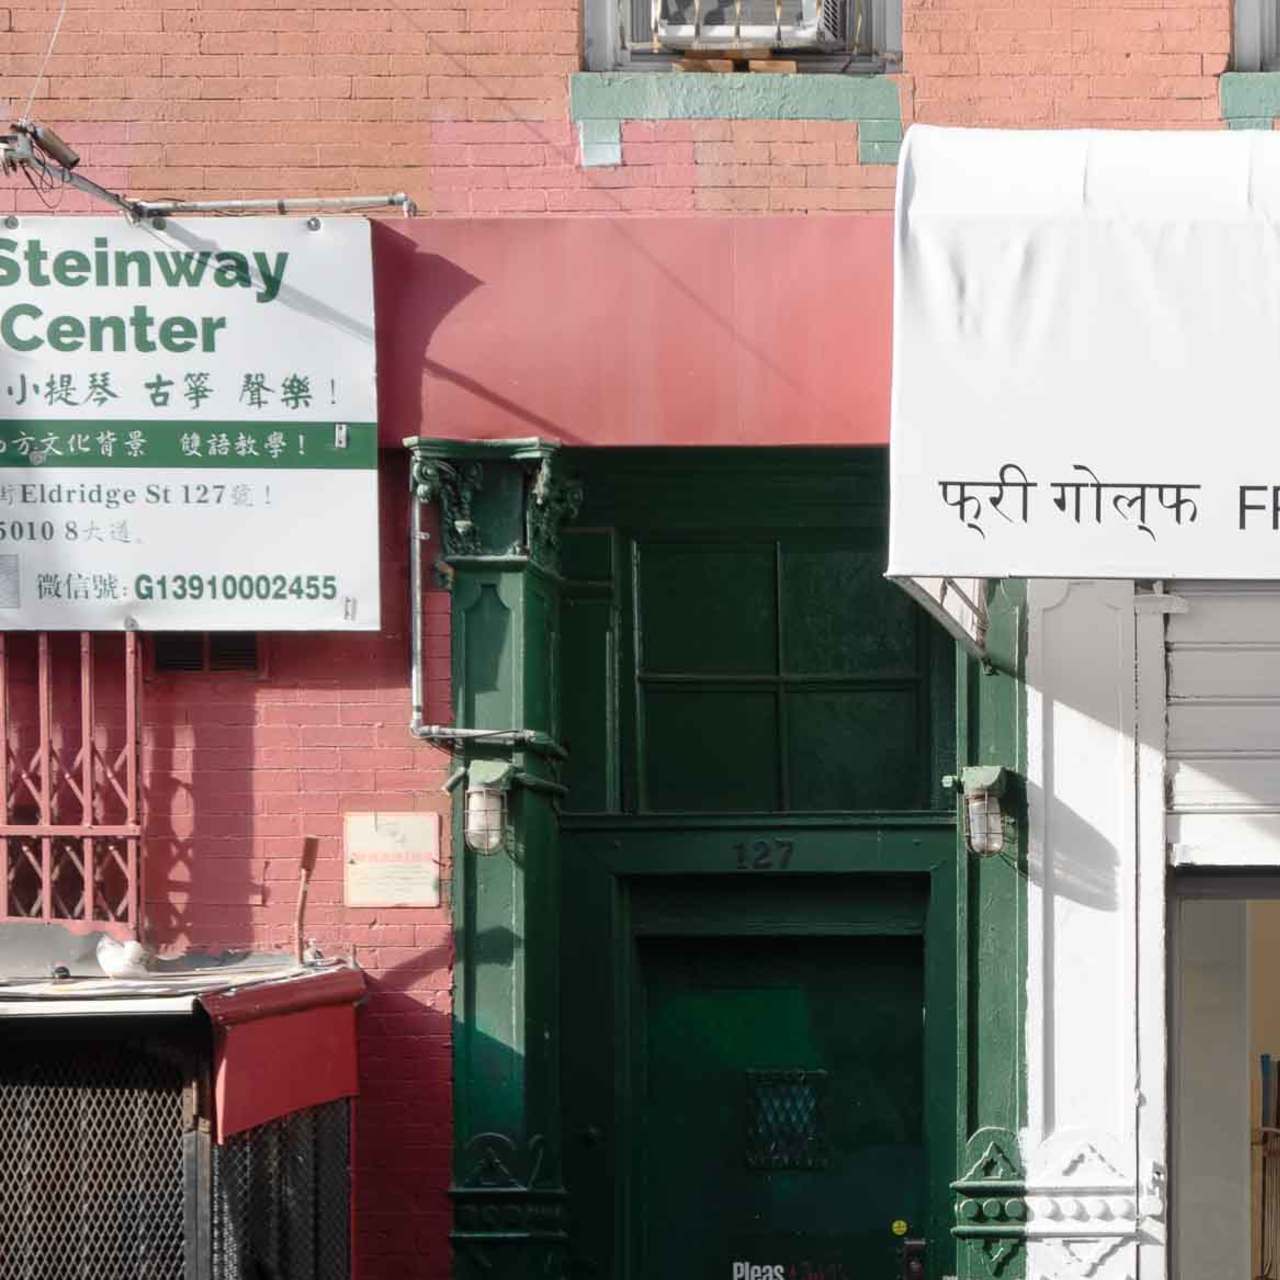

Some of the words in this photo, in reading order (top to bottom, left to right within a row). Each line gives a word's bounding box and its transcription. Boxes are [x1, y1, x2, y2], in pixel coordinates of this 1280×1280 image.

[1, 303, 227, 353] Center
[7, 371, 120, 408] 小提琴
[145, 484, 171, 504] St
[134, 574, 337, 600] G13910002455
[731, 839, 795, 870] 127
